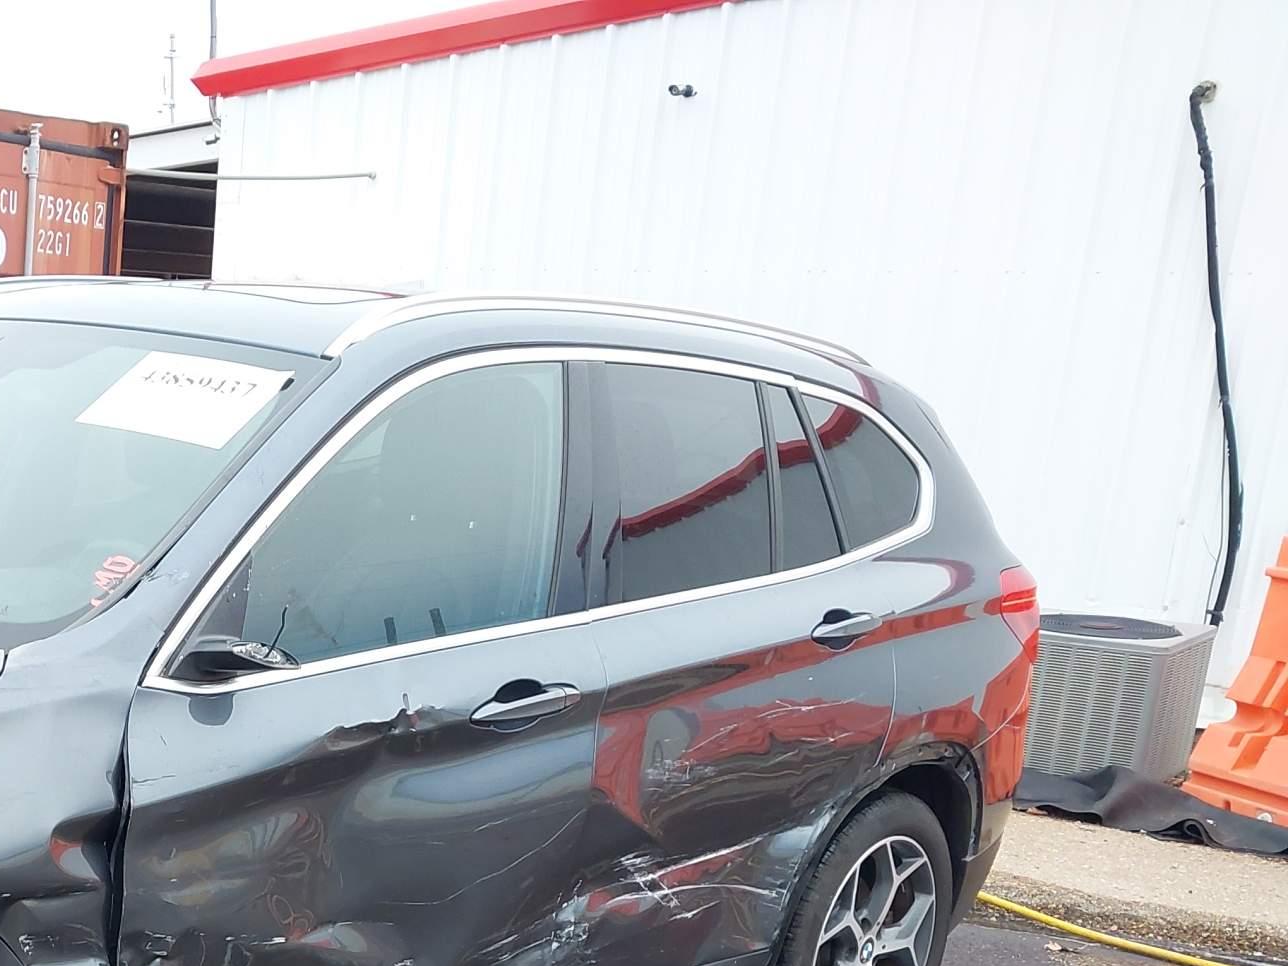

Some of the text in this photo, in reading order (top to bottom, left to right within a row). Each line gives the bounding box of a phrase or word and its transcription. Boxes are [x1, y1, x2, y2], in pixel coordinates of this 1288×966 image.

[38, 194, 90, 226] 759266
[94, 203, 105, 228] 2
[36, 228, 71, 257] 22G1
